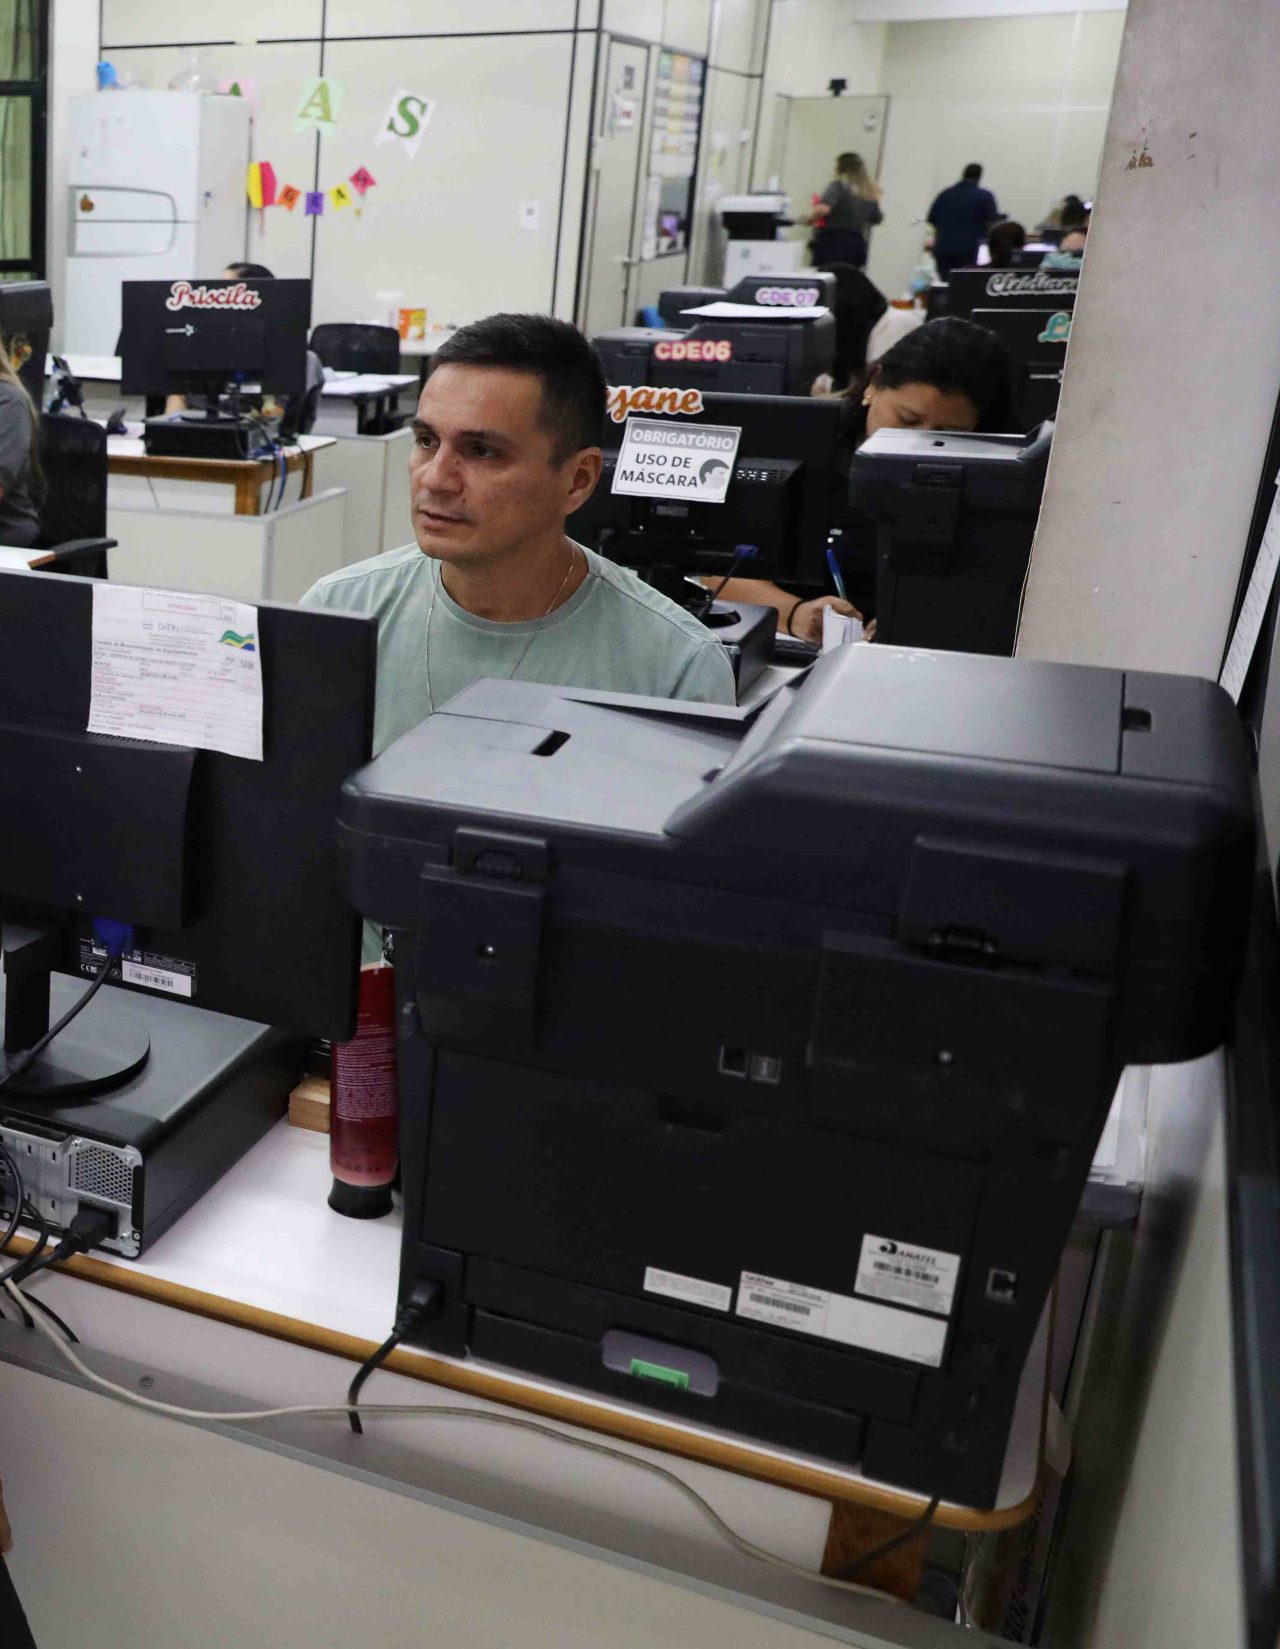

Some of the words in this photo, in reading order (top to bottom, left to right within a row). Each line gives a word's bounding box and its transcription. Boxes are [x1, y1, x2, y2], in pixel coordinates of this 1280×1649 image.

[387, 95, 428, 137] S
[168, 283, 260, 308] Priscila
[655, 341, 732, 361] CDE06
[632, 429, 734, 449] OBRIGATÓRIO
[636, 453, 667, 466] USO
[672, 456, 692, 468] DE
[620, 469, 698, 488] MÁSCARA
